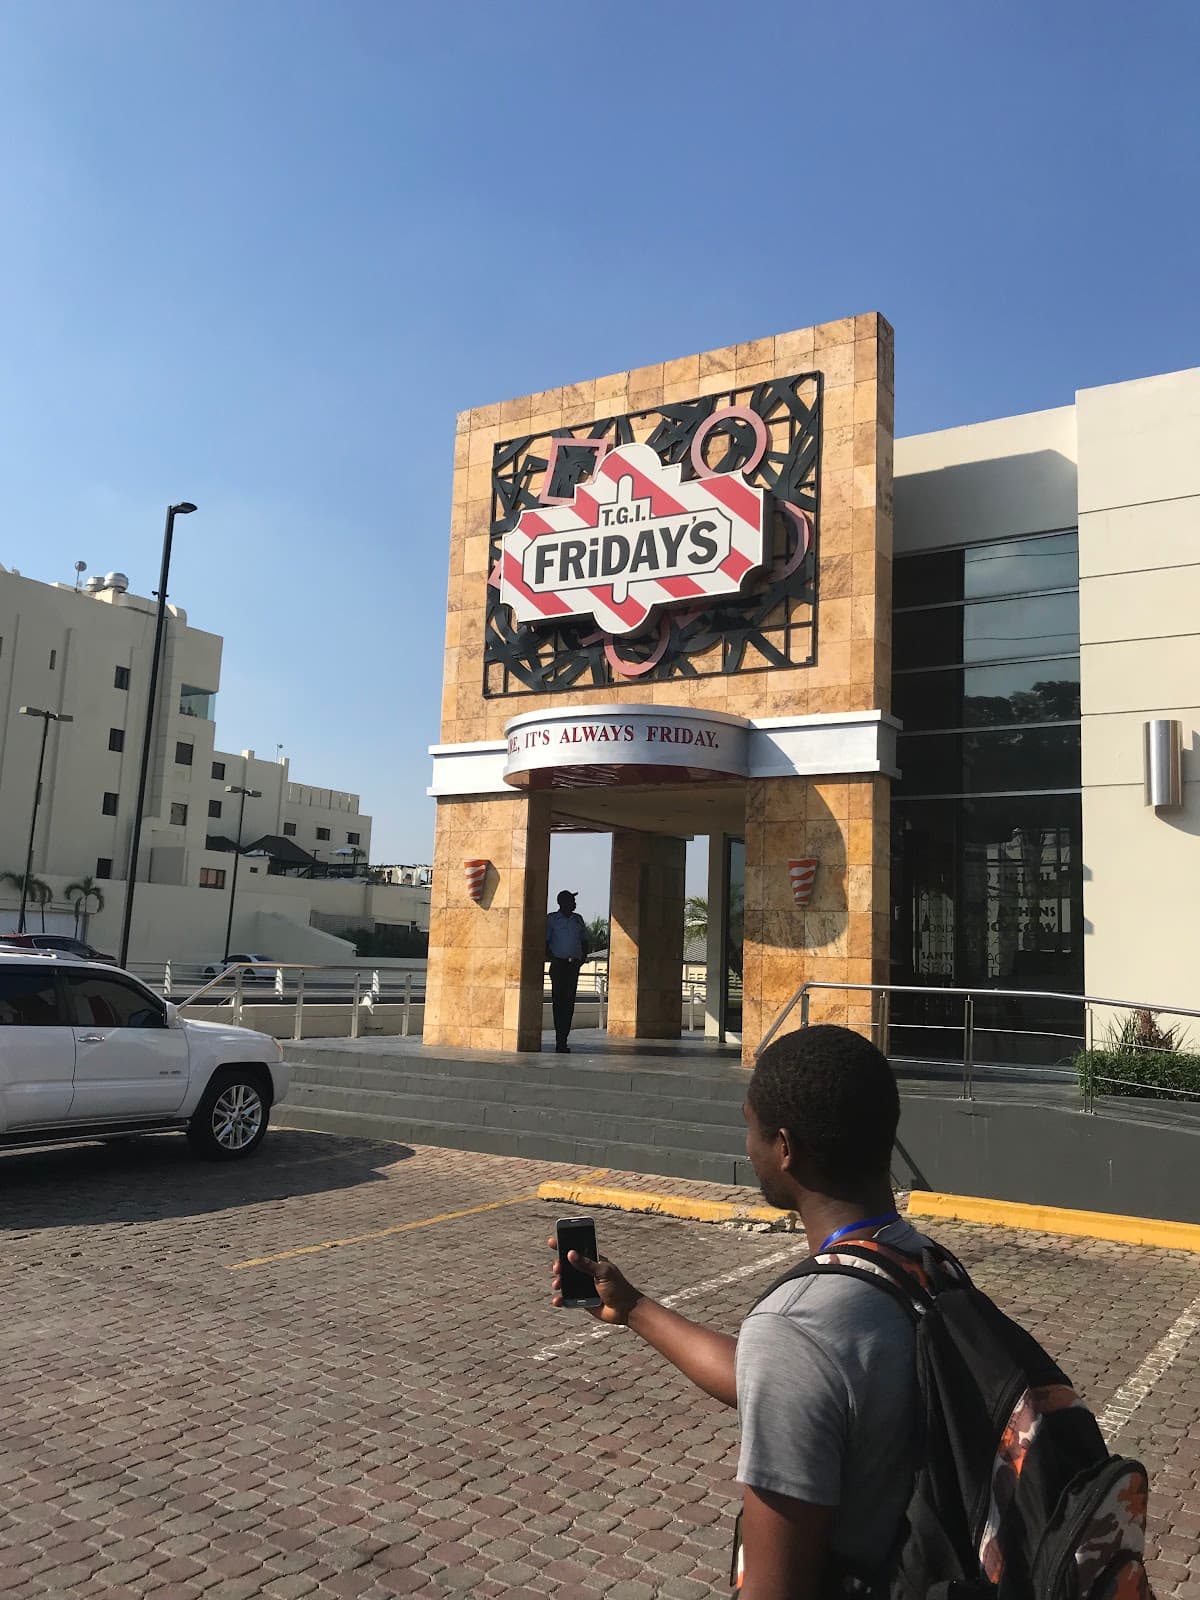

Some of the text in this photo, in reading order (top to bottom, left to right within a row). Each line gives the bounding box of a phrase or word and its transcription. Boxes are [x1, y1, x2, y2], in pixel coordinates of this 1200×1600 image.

[601, 505, 647, 526] T.G.I.
[525, 729, 550, 748] IT'S
[559, 725, 634, 743] ALWAYS
[646, 725, 719, 748] FRIDAY.
